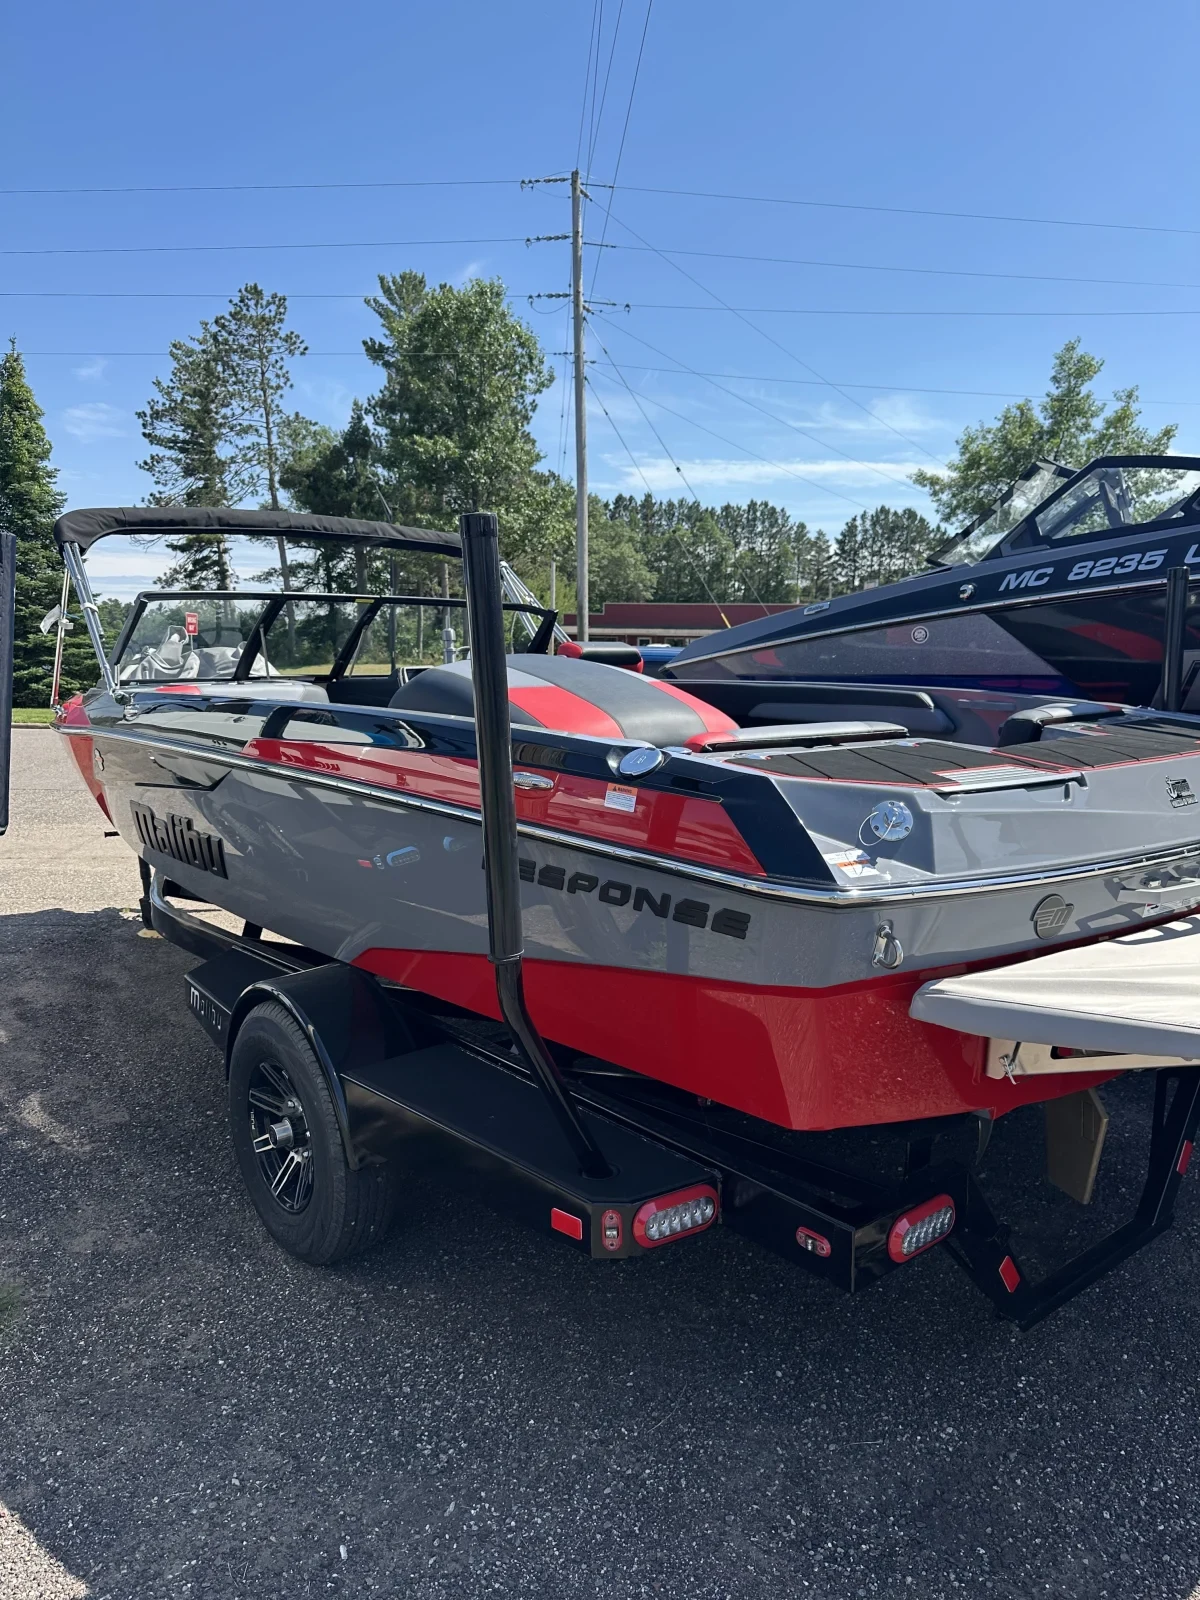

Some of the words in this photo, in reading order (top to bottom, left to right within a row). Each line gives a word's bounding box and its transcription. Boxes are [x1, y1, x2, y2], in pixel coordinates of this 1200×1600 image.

[998, 567, 1054, 592] MC
[1067, 549, 1168, 581] 8235
[129, 799, 229, 880] Malibu
[482, 856, 751, 940] ESPONSE
